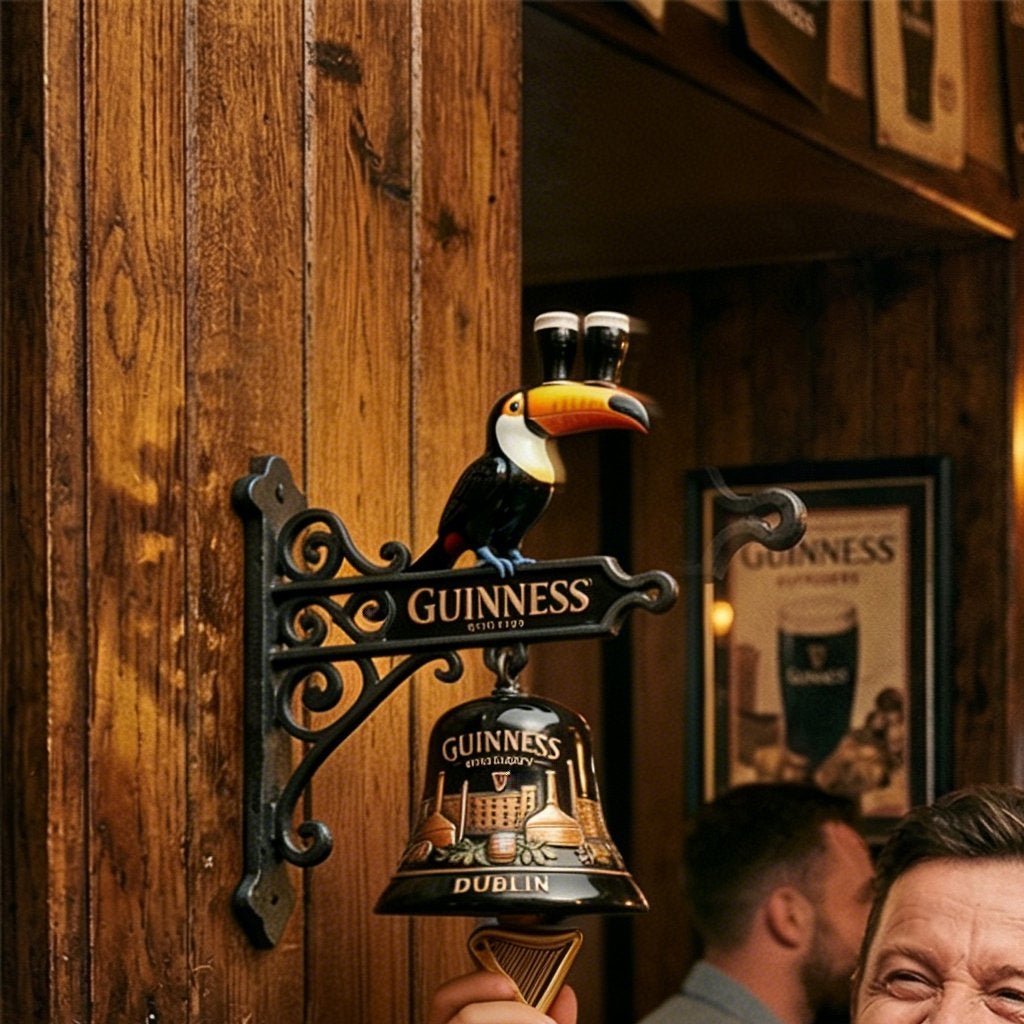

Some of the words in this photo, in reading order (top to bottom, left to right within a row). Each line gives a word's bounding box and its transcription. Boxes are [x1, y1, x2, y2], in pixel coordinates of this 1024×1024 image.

[407, 578, 593, 624] GUINNESS
[442, 729, 562, 762] GUINNESS
[453, 875, 549, 894] DUBLIN
